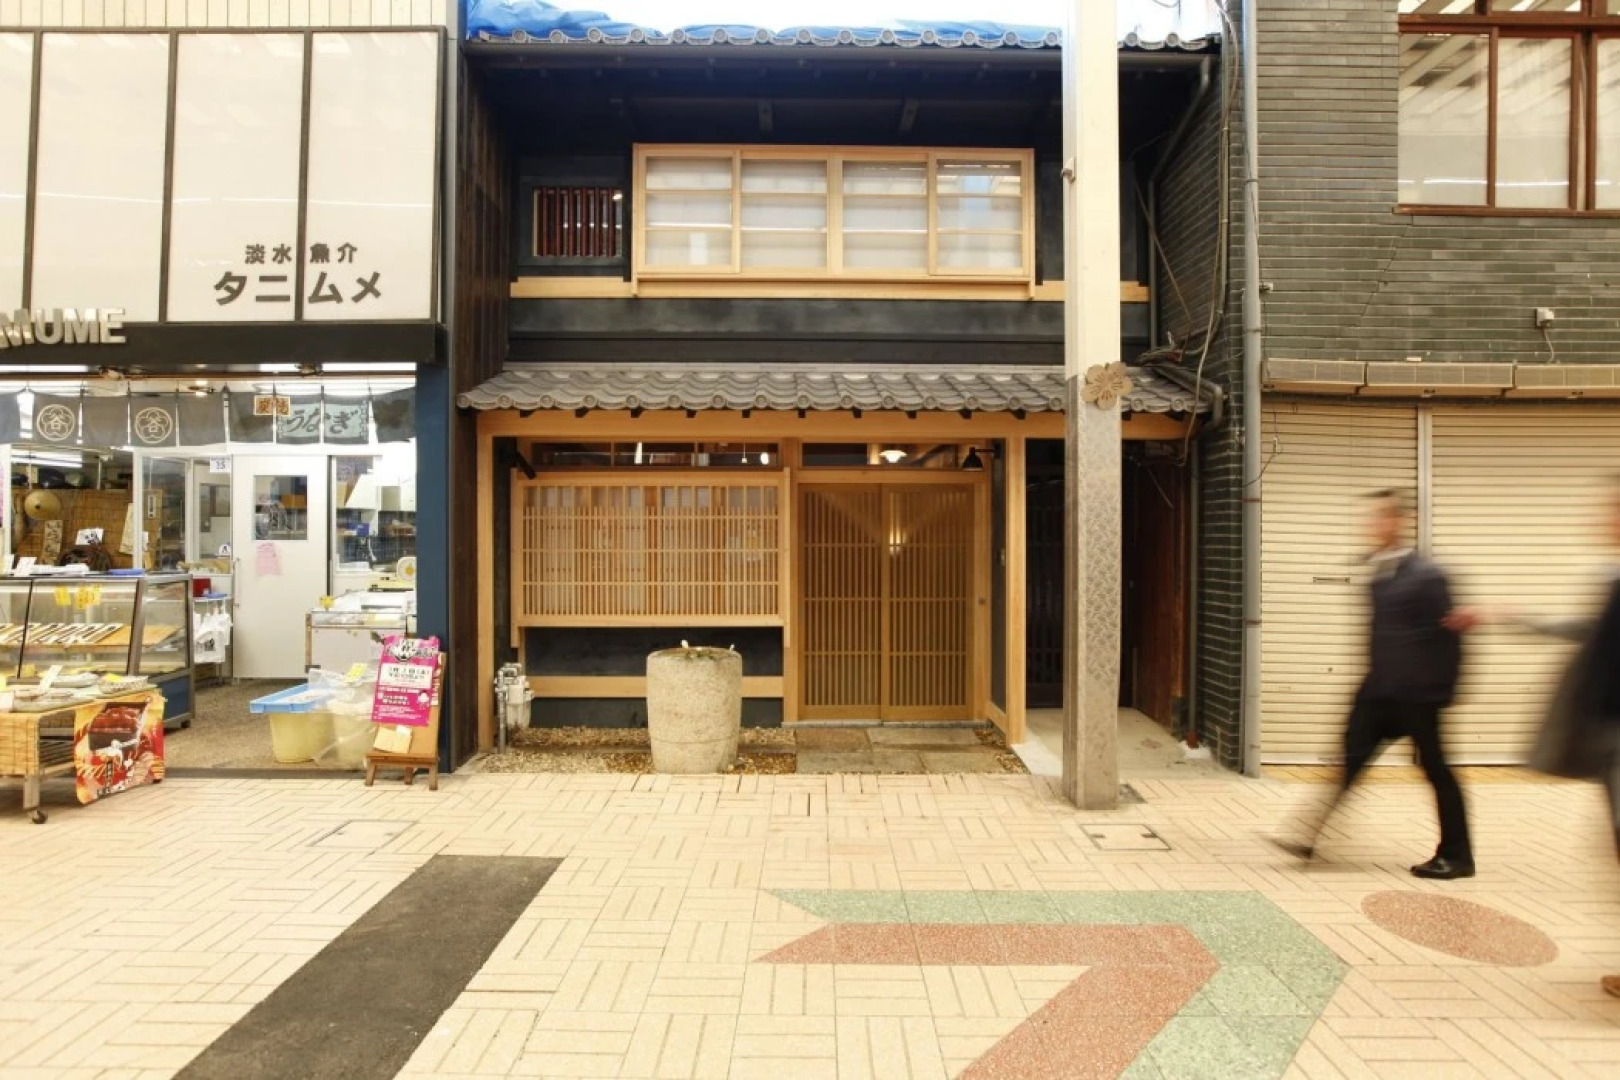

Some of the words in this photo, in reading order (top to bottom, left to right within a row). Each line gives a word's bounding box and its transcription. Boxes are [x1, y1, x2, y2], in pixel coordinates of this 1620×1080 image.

[245, 243, 358, 264] 淡水魚介
[214, 271, 381, 306] タニムメ
[286, 407, 359, 433] うなぎ
